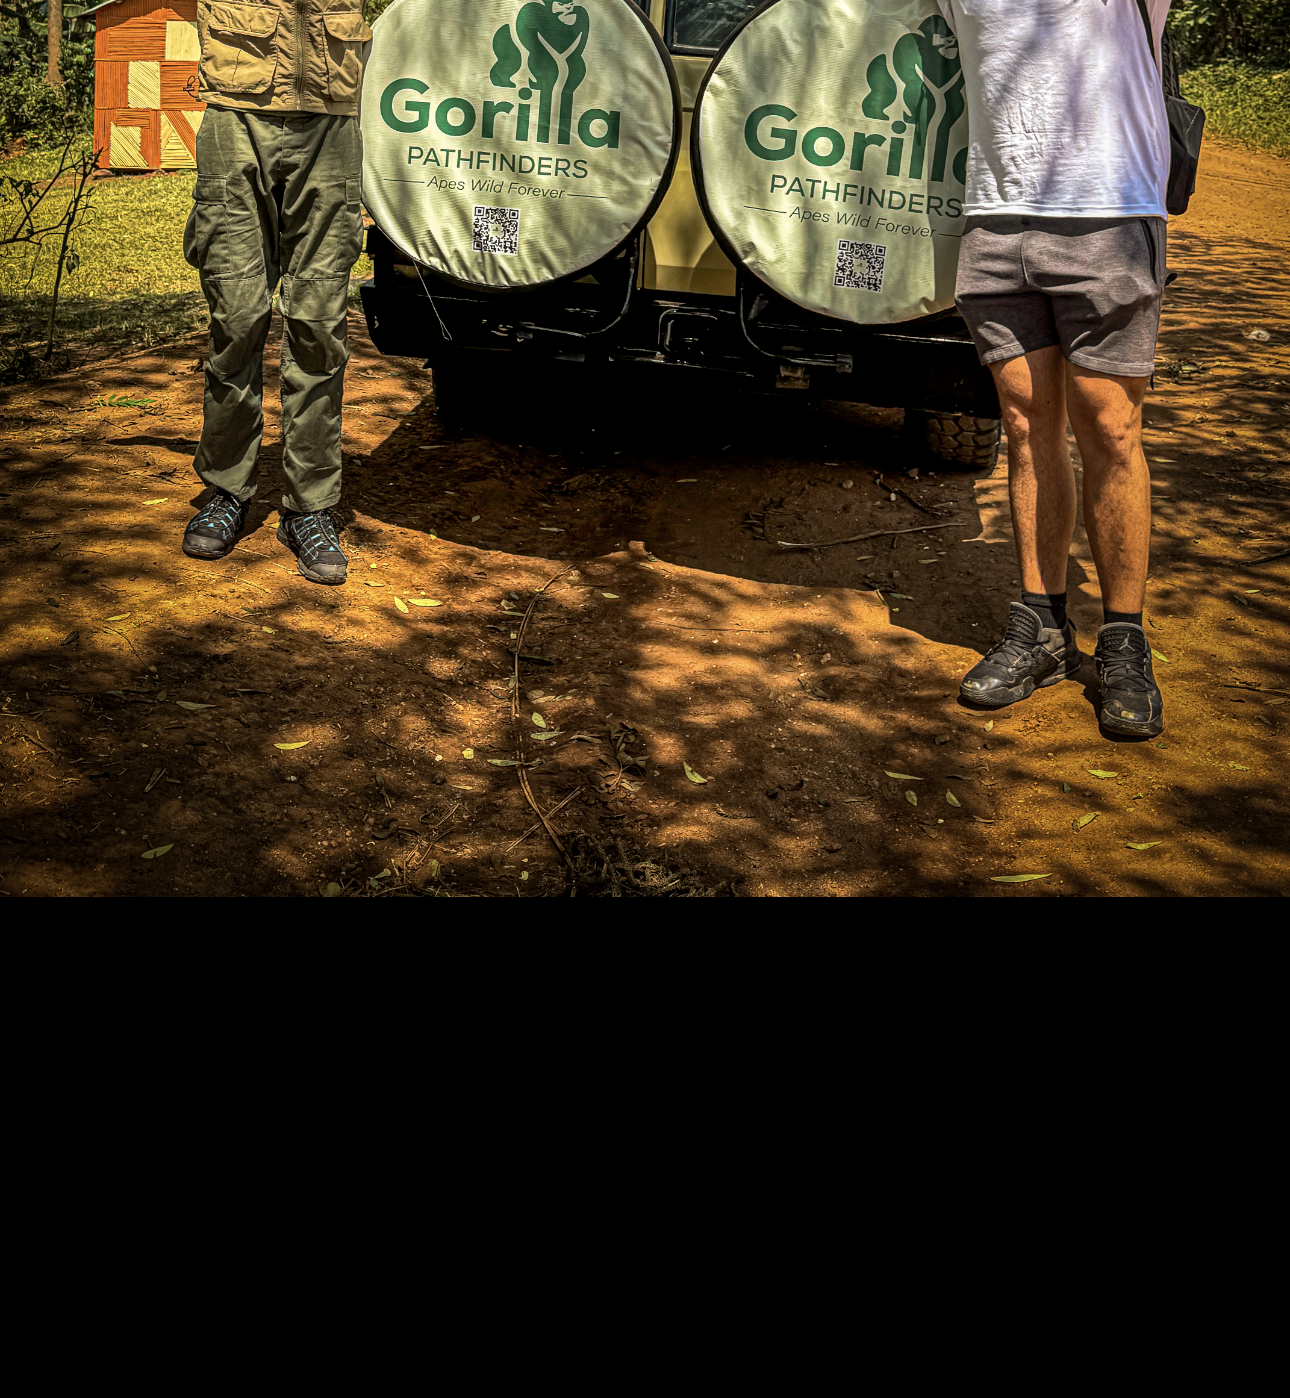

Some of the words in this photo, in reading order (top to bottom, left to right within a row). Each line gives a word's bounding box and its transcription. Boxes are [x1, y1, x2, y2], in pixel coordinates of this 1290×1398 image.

[379, 78, 621, 149] Gorilla
[407, 146, 588, 179] PATHFINDERS
[427, 175, 465, 191] Apes
[470, 178, 503, 194] Wild
[507, 183, 565, 199] Forever
[769, 174, 962, 218] PATHFINDERS
[788, 205, 830, 223] Apes
[836, 211, 870, 228] Wild
[874, 217, 937, 238] Forever
